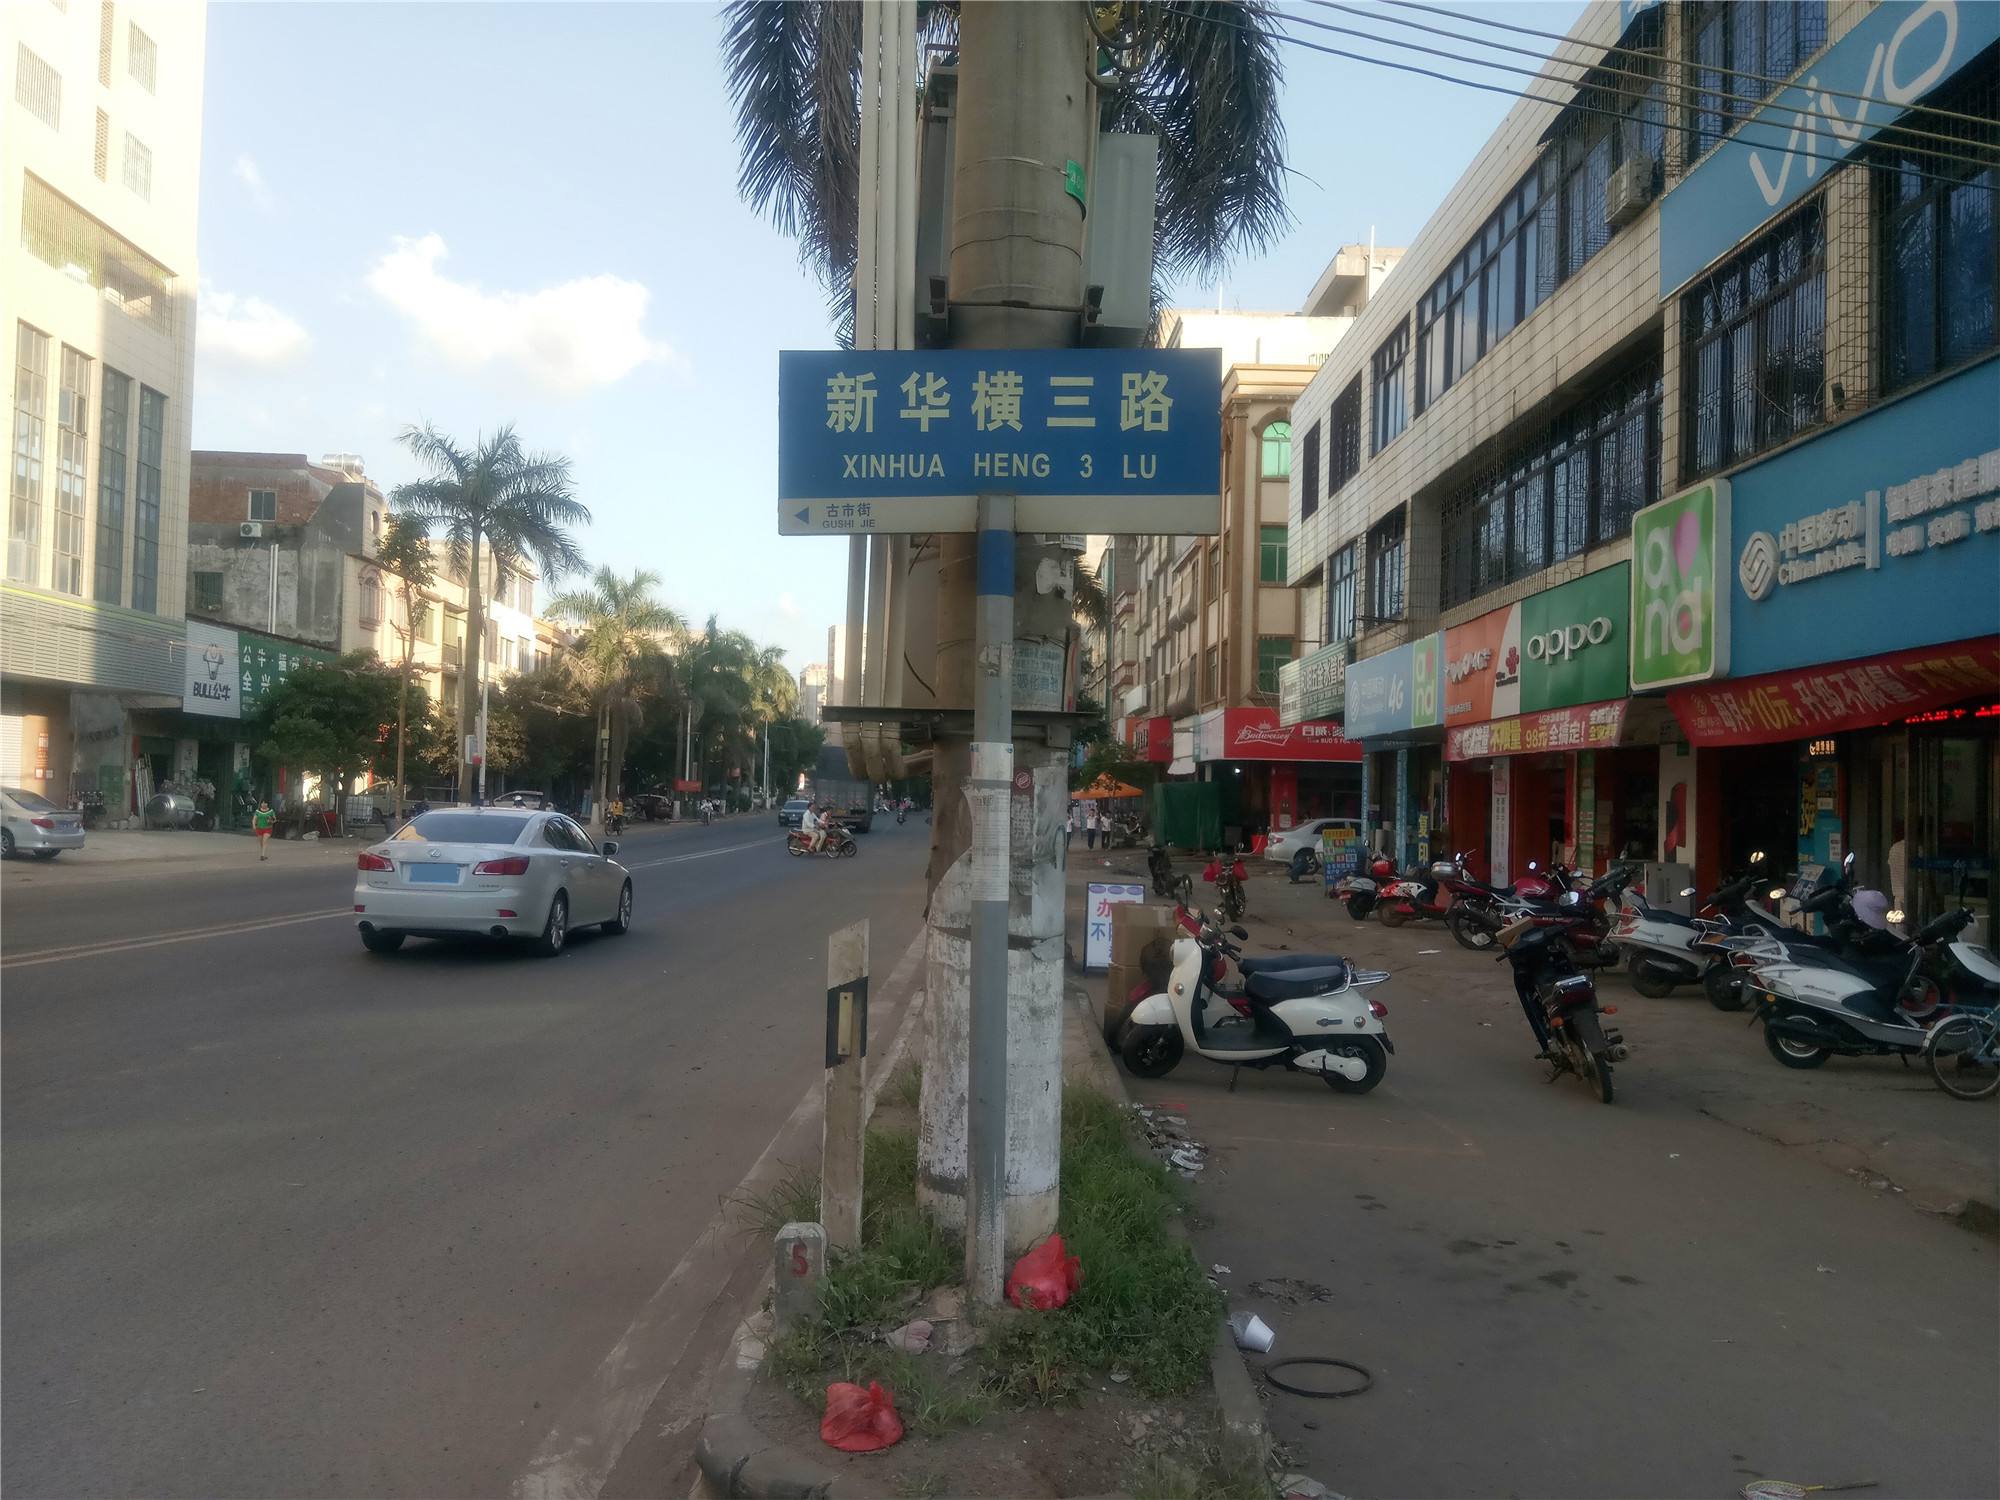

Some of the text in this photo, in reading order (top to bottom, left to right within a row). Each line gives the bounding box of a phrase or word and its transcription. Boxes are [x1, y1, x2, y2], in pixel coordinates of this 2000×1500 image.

[1750, 0, 1958, 206] vivo
[825, 370, 1174, 433] 新华横三路
[842, 453, 1157, 479] XINHUA HENG 3 LU
[822, 518, 876, 529] GUSHI JIE
[825, 502, 872, 518] 古市街
[1527, 616, 1613, 664] oppo
[1388, 673, 1404, 716] 4G
